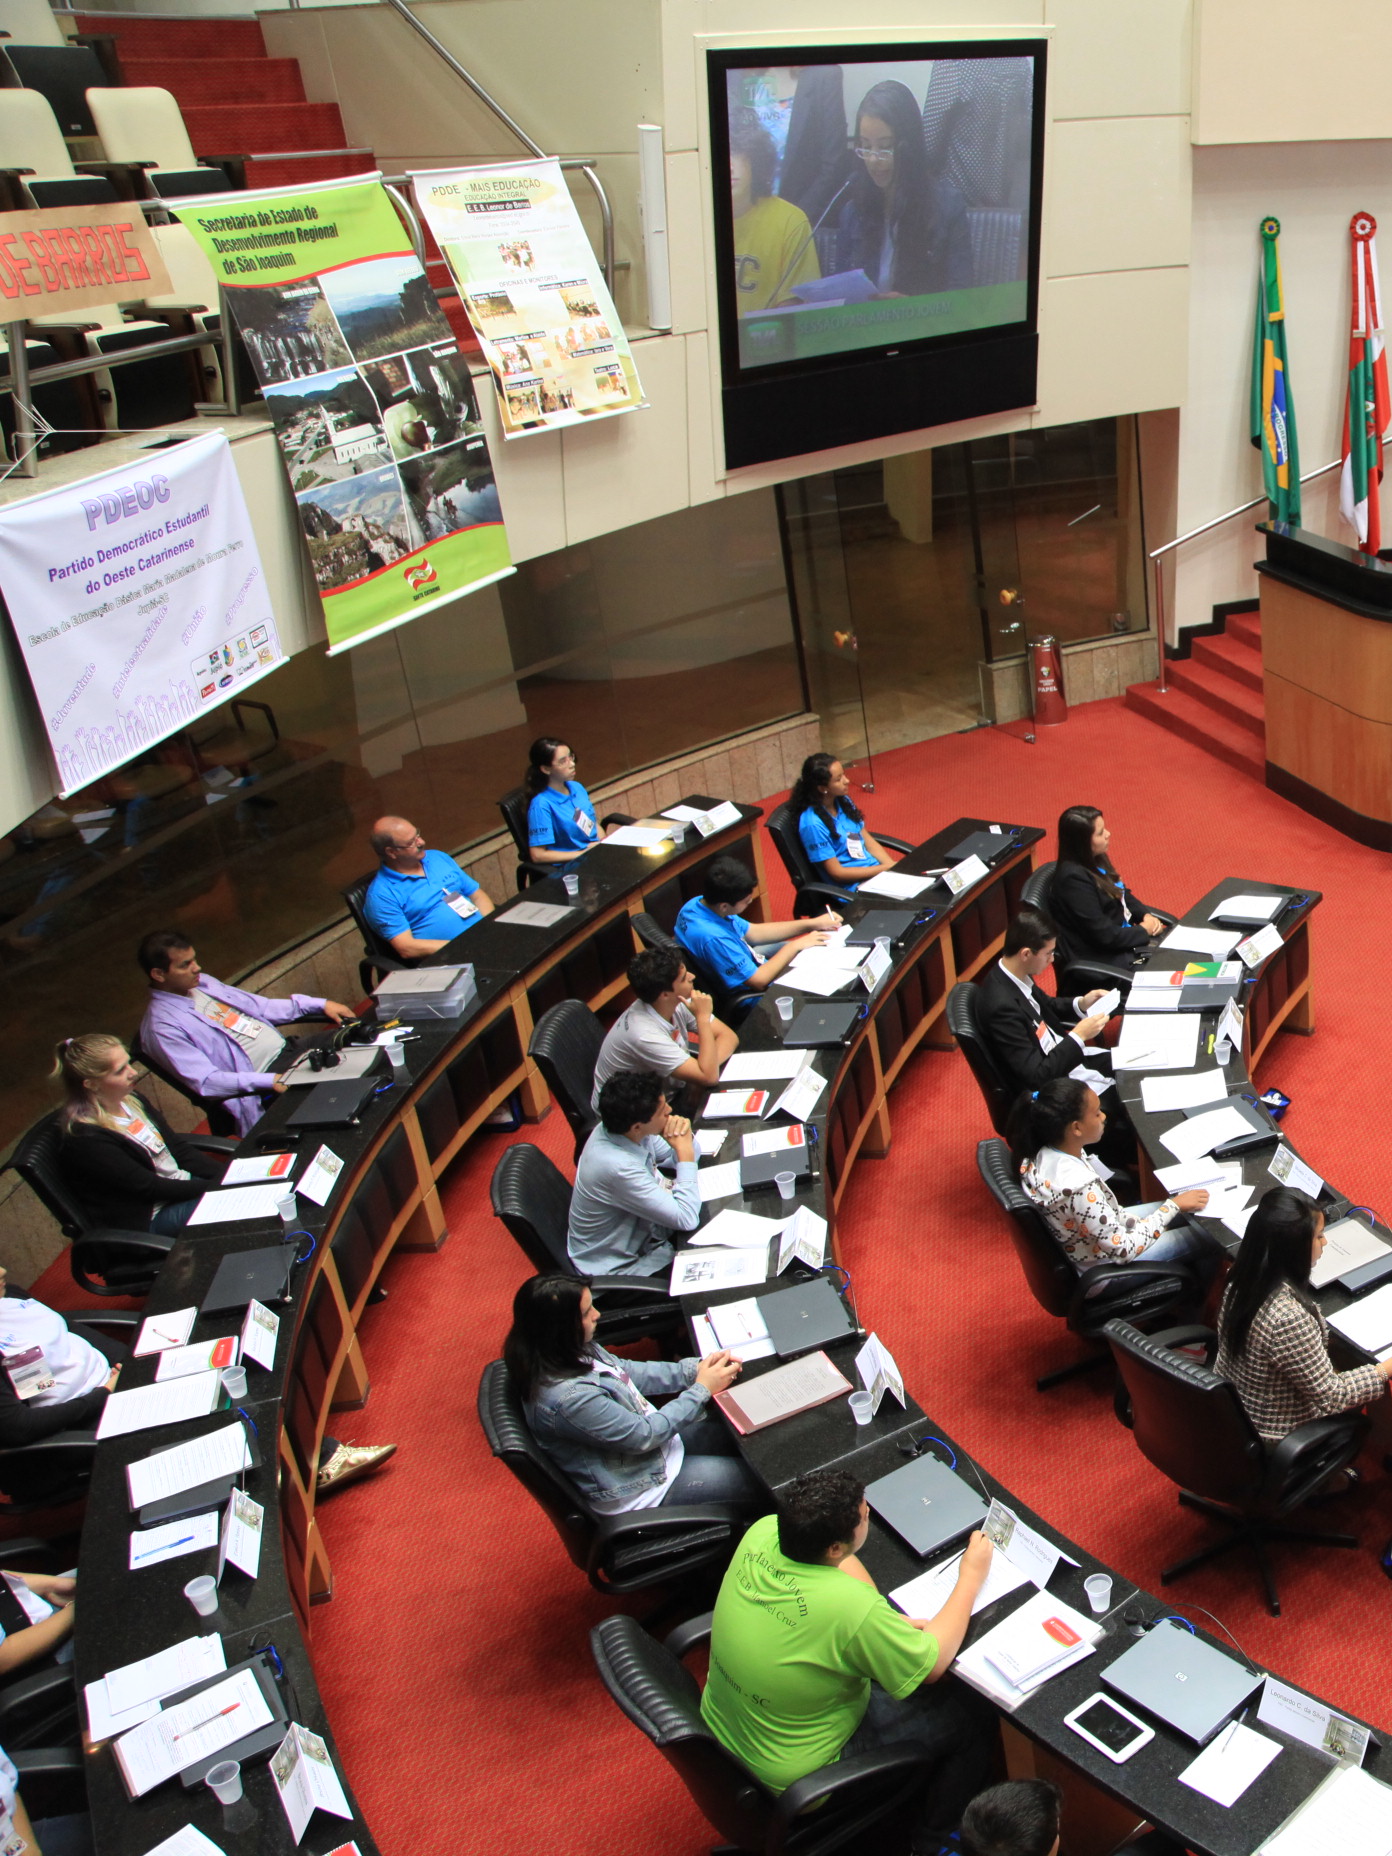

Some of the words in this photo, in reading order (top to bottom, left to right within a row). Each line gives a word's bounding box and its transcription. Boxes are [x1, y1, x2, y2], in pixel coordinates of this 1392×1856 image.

[432, 184, 461, 196] PDDE
[470, 182, 490, 193] MAIS
[492, 178, 541, 191] EDUCAÇÃO
[464, 193, 497, 202] EDUCAÇÃO
[496, 191, 527, 200] INTEGRAL
[197, 212, 257, 234] Secretaria
[258, 210, 273, 227] de
[271, 208, 304, 225] Estado
[303, 205, 318, 220] de
[211, 229, 297, 254] Desenvolvimento
[296, 222, 340, 244] Regional
[20, 223, 151, 293] BARROS
[222, 258, 237, 275] de
[236, 254, 258, 273] São
[841, 306, 915, 328] PARLAMENTO
[80, 474, 171, 532] PDEOC
[48, 556, 95, 583] Partido
[96, 527, 164, 564] Democrático
[165, 503, 211, 535] Estudantil
[86, 579, 101, 595] do
[103, 563, 136, 587] Oeste
[138, 537, 195, 572] Catarinense
[785, 1577, 809, 1617] Jovem
[776, 1611, 797, 1629] Cruz
[751, 1694, 771, 1709] SC
[1270, 1688, 1296, 1706] Leonardo
[1304, 1706, 1311, 1714] da
[1312, 1710, 1326, 1722] Silva
